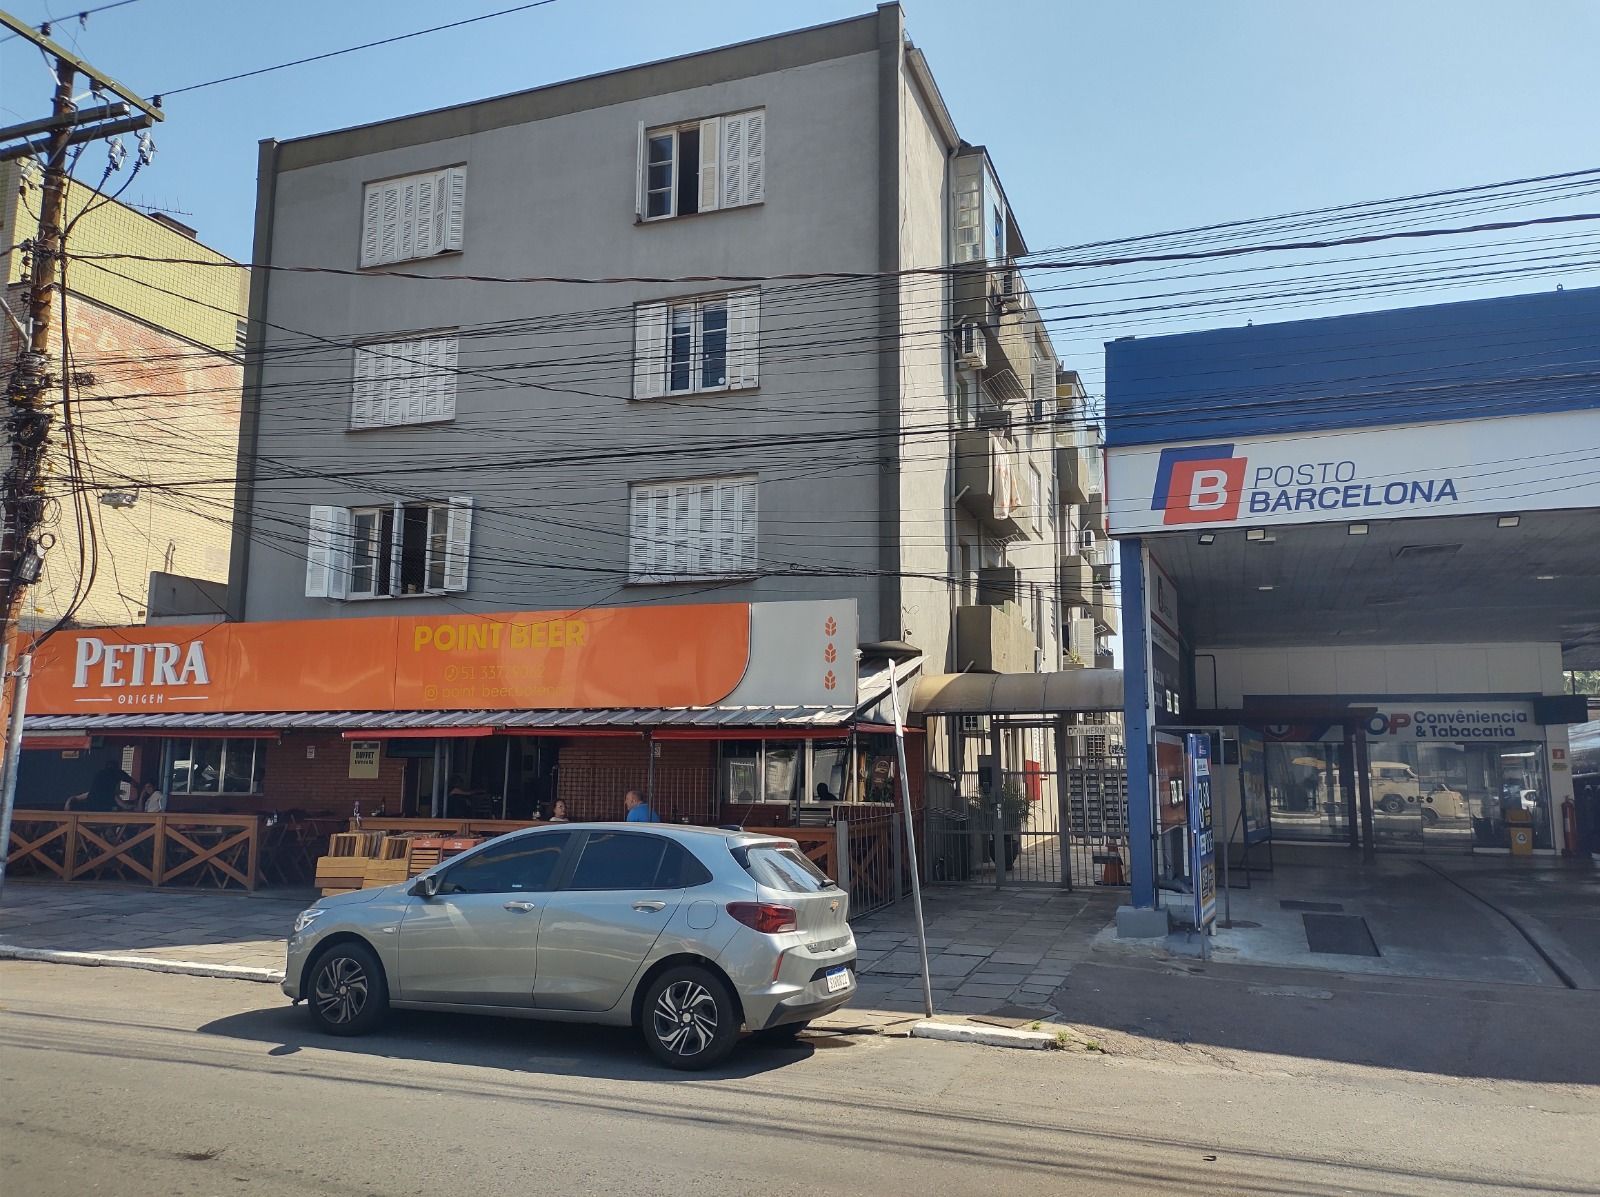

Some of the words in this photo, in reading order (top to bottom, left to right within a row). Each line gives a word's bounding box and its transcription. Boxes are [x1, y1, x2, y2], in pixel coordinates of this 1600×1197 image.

[1254, 461, 1355, 488] POSTO
[1189, 469, 1228, 510] B
[1250, 479, 1458, 513] BARCELONA
[413, 623, 503, 652] POINT
[510, 620, 587, 649] BEER
[72, 638, 210, 687] PETRA
[461, 665, 476, 680] 51
[1414, 709, 1527, 724] Convêniencia
[1415, 725, 1426, 737] &
[1429, 725, 1516, 738] Tabacaria
